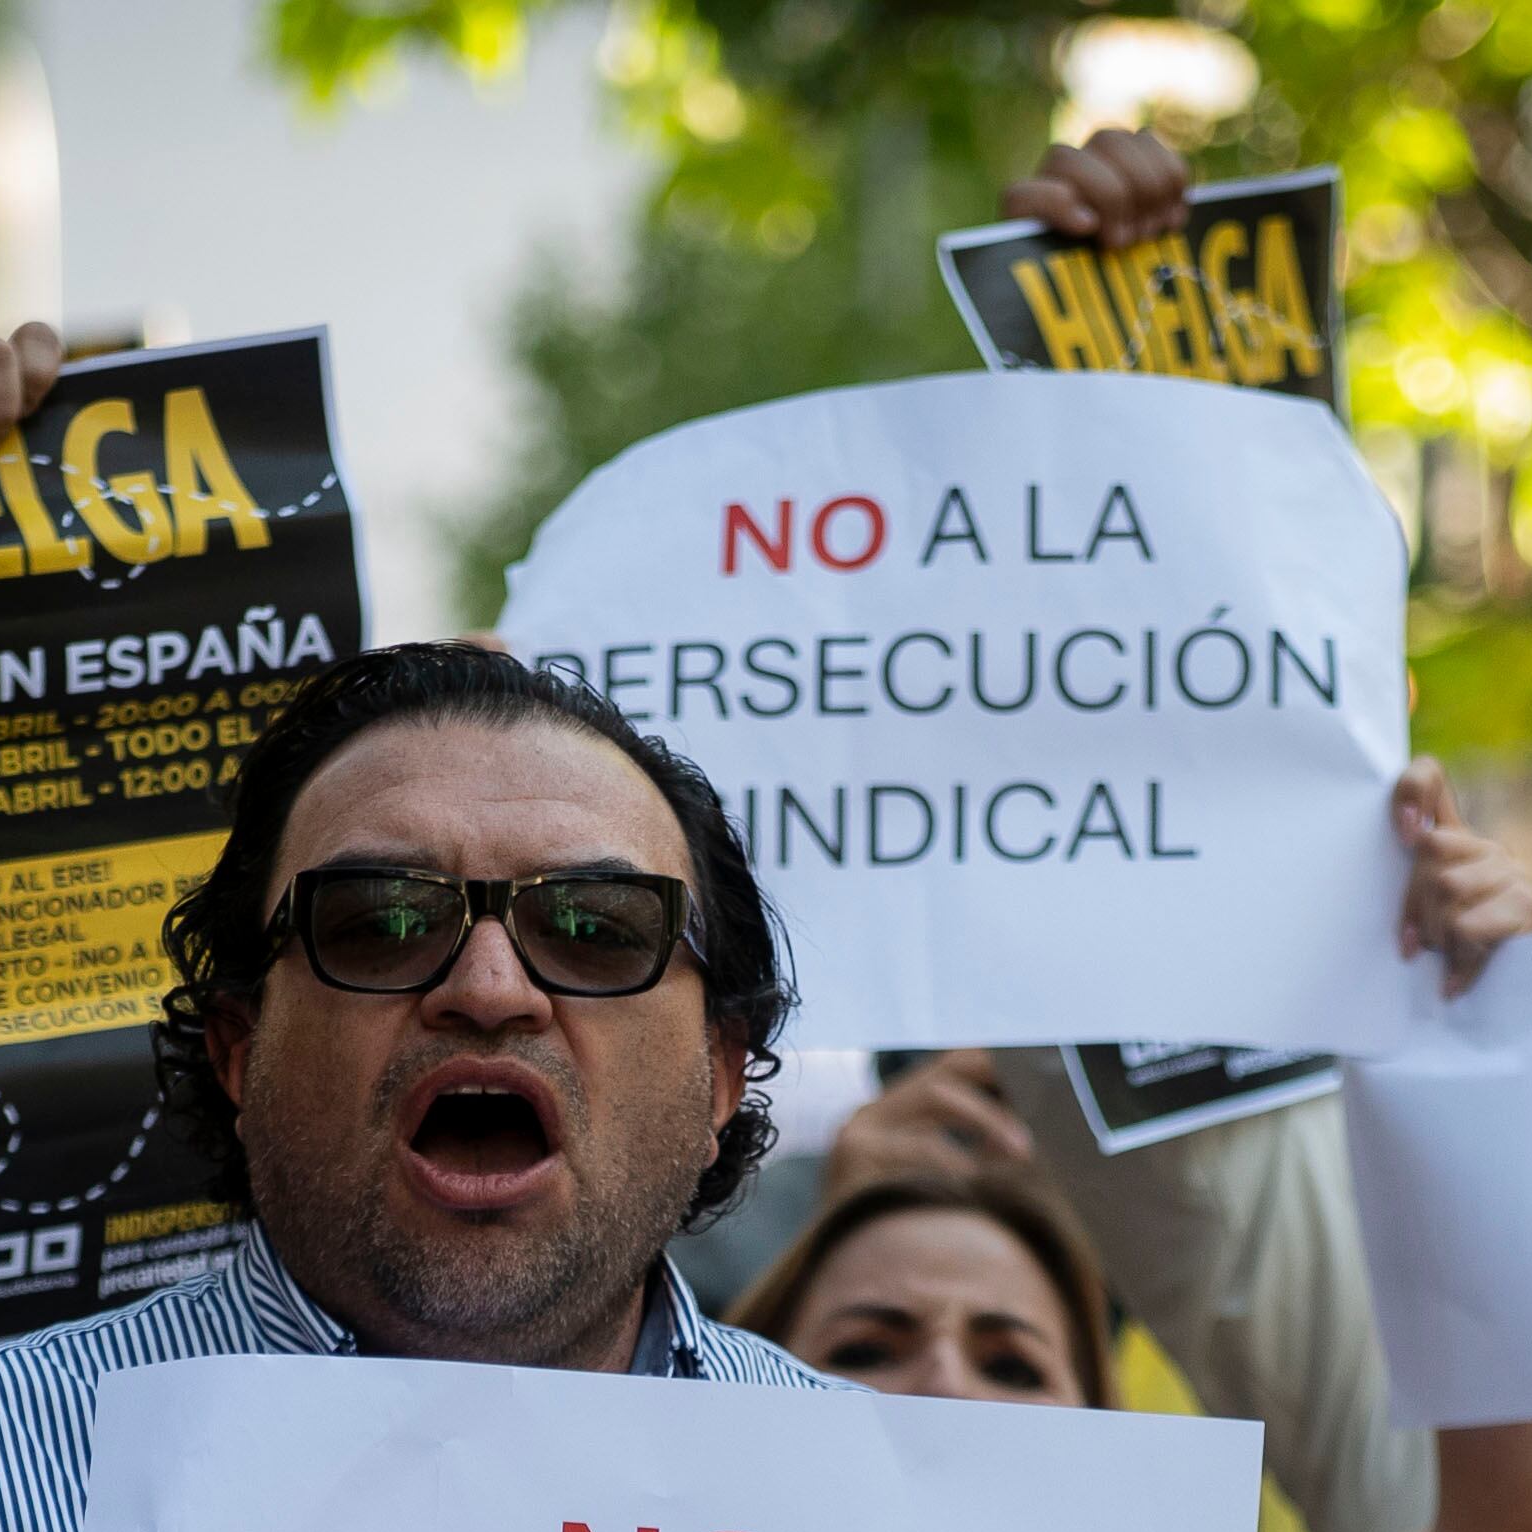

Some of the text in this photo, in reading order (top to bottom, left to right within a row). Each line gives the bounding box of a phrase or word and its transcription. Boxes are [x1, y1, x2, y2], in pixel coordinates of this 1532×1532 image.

[1010, 215, 1321, 383] HUELGA
[721, 482, 1155, 577] NO A LA
[65, 604, 335, 696] ESPAÑA
[94, 692, 199, 731] 20:00
[203, 687, 232, 713] A
[105, 718, 212, 763] TODO
[217, 713, 262, 747] EL
[119, 756, 213, 800] 12:00
[725, 780, 1201, 870] INDICAL
[9, 871, 46, 895] AL
[16, 966, 163, 1006] CONVENIO
